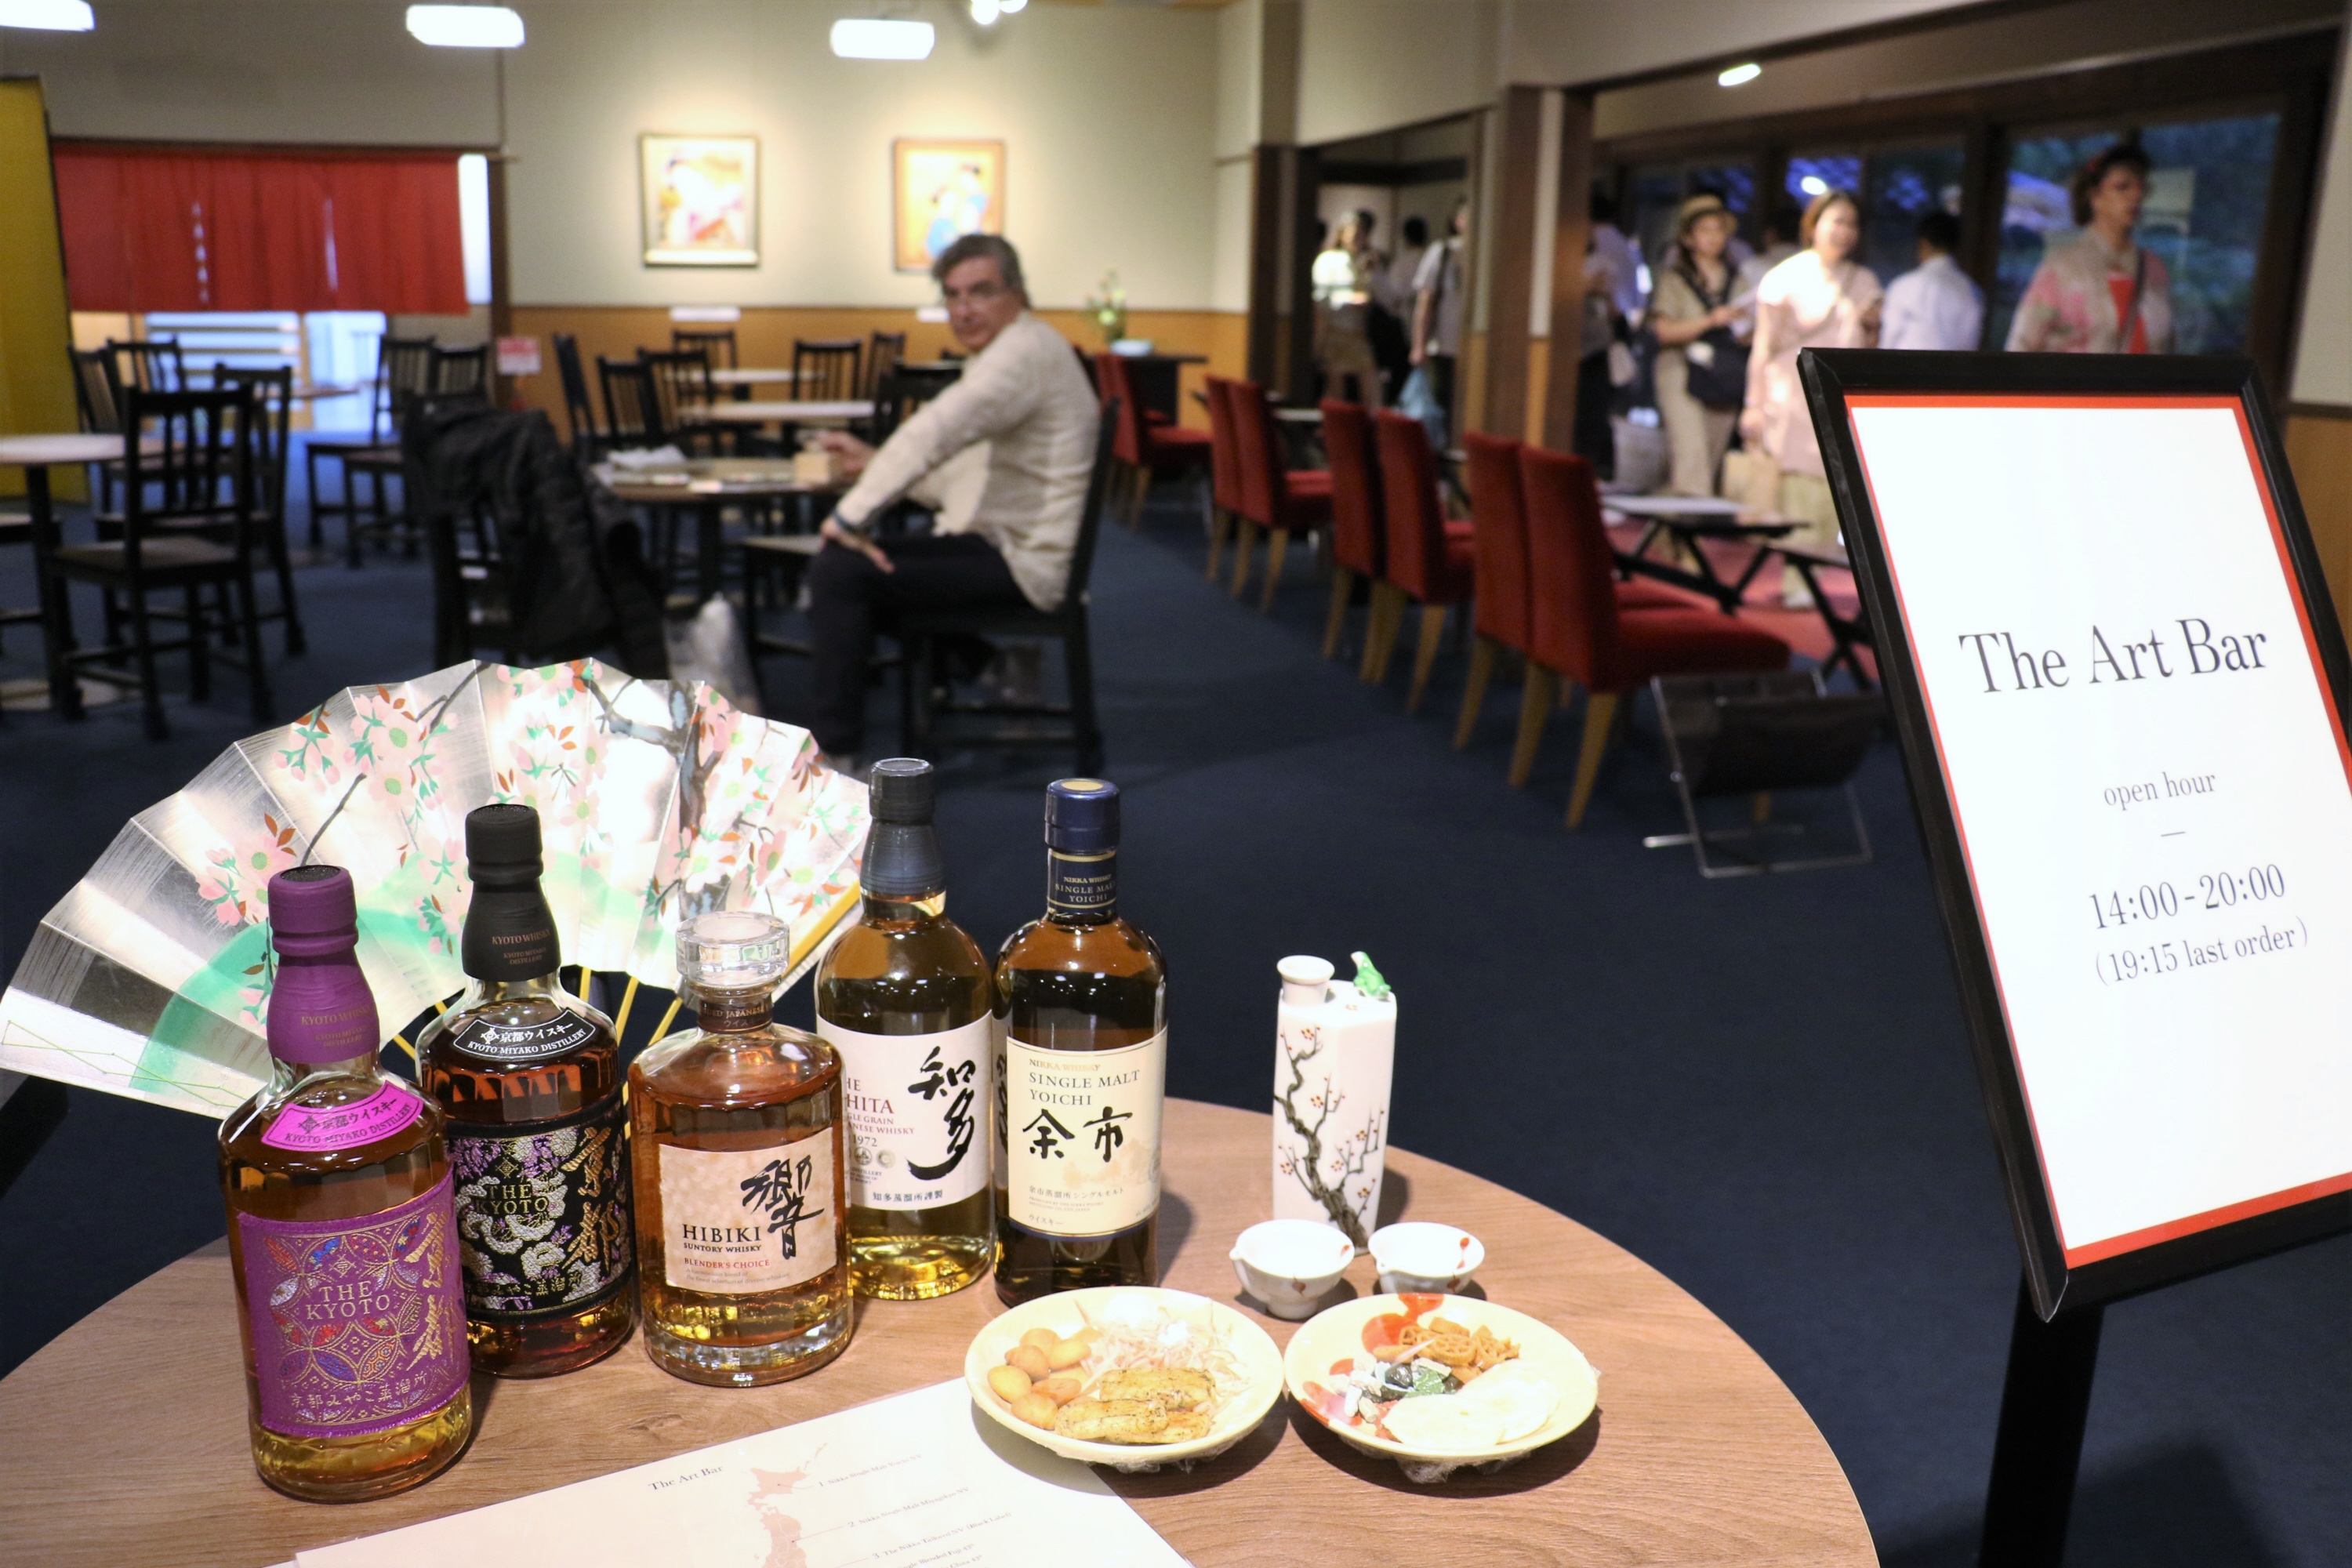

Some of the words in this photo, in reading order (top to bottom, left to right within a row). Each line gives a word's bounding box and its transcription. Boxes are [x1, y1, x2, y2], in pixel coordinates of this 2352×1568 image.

[1958, 632, 2070, 693] The
[2089, 625, 2173, 684] Art
[2176, 618, 2267, 674] Bar
[2103, 778, 2159, 811] open
[2161, 771, 2216, 798] hour
[1054, 884, 1094, 894] SINGLE
[1069, 894, 1107, 903] YOICHI
[492, 935, 522, 945] KYOTO
[2095, 942, 2179, 986] (19:15
[2182, 938, 2228, 968] last
[2234, 915, 2308, 958] order)
[510, 955, 543, 964] DISTILLERY
[301, 1015, 337, 1025] KYOTO
[726, 1006, 764, 1018] JAPANESE
[499, 1022, 574, 1043] 京都ウイスキー
[467, 1041, 498, 1054] KYOTO
[499, 1046, 539, 1054] MIYAKO
[541, 1029, 587, 1052] DISTILLERY
[1029, 1058, 1060, 1071] NIKKA
[1062, 1063, 1101, 1072] WHISKY
[847, 1077, 861, 1091] HE
[1029, 1072, 1092, 1089] SINGLE
[1098, 1069, 1141, 1088] MALT
[847, 1094, 895, 1114] HITA
[1029, 1089, 1092, 1105] YOICHI
[863, 1116, 894, 1125] GRAIN
[907, 1045, 976, 1181] 知多
[285, 1132, 321, 1144] KYOTO
[325, 1130, 368, 1143] MIYAKO
[368, 1103, 413, 1135] DISTILLERY
[877, 1126, 915, 1134] WHISKY
[853, 1134, 878, 1147] 1972
[1022, 1105, 1134, 1163] 余市
[486, 1184, 533, 1200] THE
[475, 1197, 549, 1214] KYOTO
[740, 1154, 825, 1260] 響
[1029, 1214, 1063, 1226] ウイスキー
[682, 1223, 761, 1243] HIBIKI
[684, 1242, 723, 1253] SUNTORY
[725, 1244, 761, 1253] WHISKY
[684, 1258, 731, 1269] BLENDER'S
[733, 1259, 770, 1269] CHOICE
[318, 1280, 373, 1303] THE
[306, 1294, 390, 1320] KYOTO
[648, 1479, 675, 1491] The
[678, 1472, 699, 1484] Art
[700, 1465, 724, 1477] Bar
[827, 1475, 849, 1485] Nikka
[858, 1515, 880, 1525] Nikka
[882, 1548, 898, 1557] The
[898, 1540, 921, 1552] Nikka
